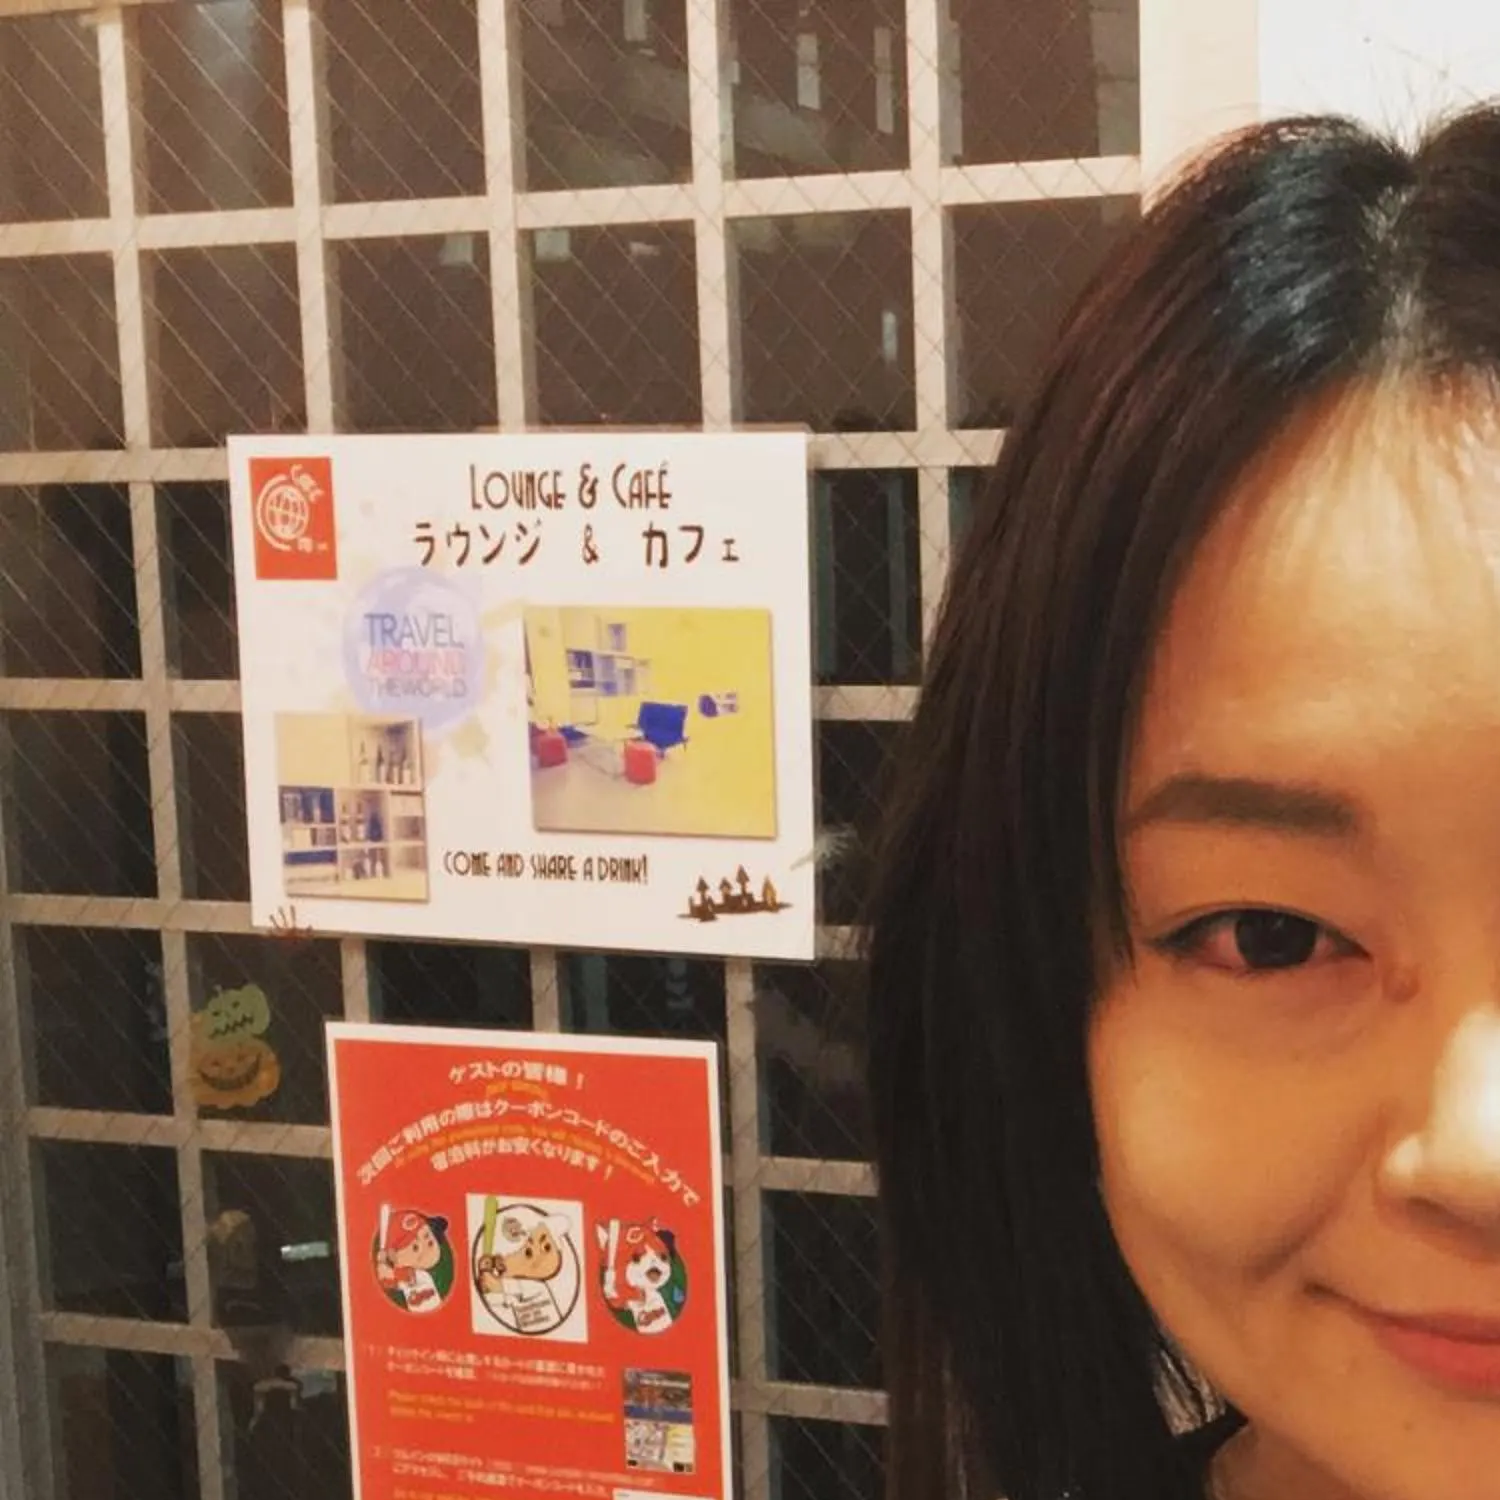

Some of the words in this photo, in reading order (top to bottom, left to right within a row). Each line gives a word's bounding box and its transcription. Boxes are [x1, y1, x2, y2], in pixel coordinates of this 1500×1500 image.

[578, 463, 599, 509] &
[413, 518, 542, 567] ラウンジ
[582, 523, 599, 565] &
[642, 520, 740, 568] カフェ
[364, 612, 465, 649] TRAVEL
[443, 851, 491, 877] COME
[496, 852, 526, 878] AND
[530, 853, 577, 881] SHARE
[583, 856, 594, 881] A
[597, 853, 650, 885] DRINK!
